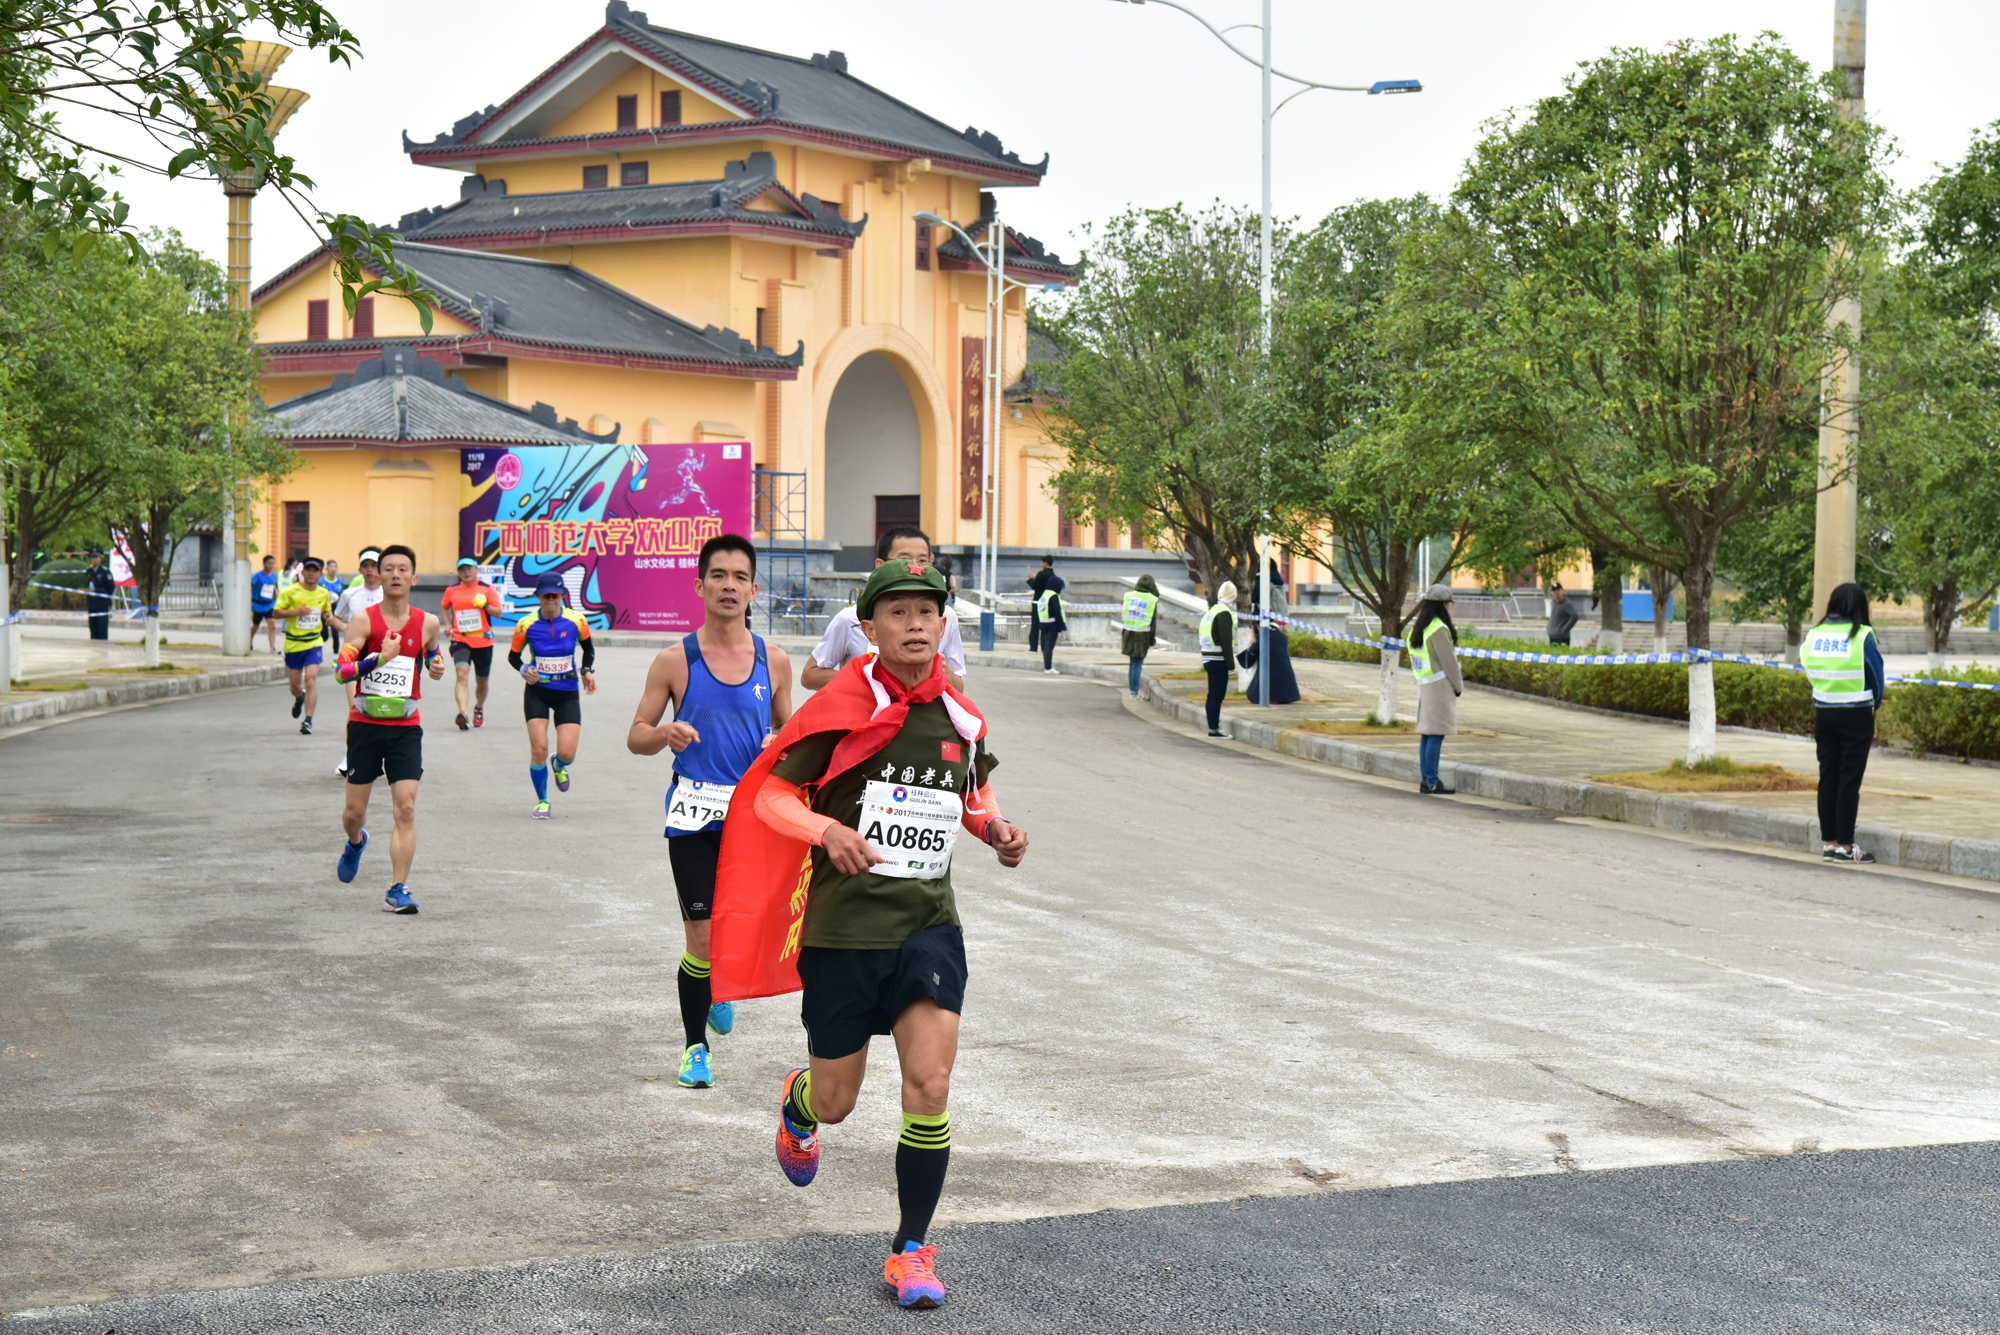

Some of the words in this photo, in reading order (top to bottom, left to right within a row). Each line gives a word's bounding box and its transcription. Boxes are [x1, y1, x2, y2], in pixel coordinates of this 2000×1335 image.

[474, 517, 722, 556] 广西师范大学欢迎您
[634, 557, 676, 569] 山水文化城
[297, 615, 319, 624] A2514
[458, 618, 479, 626] A0930
[1813, 637, 1849, 653] 综合执法
[537, 662, 569, 673] A5338
[363, 671, 407, 687] A2253
[880, 762, 955, 788] 中国老兵
[910, 789, 936, 799] 桂林银行
[670, 800, 725, 822] A178
[864, 820, 946, 852] A0865
